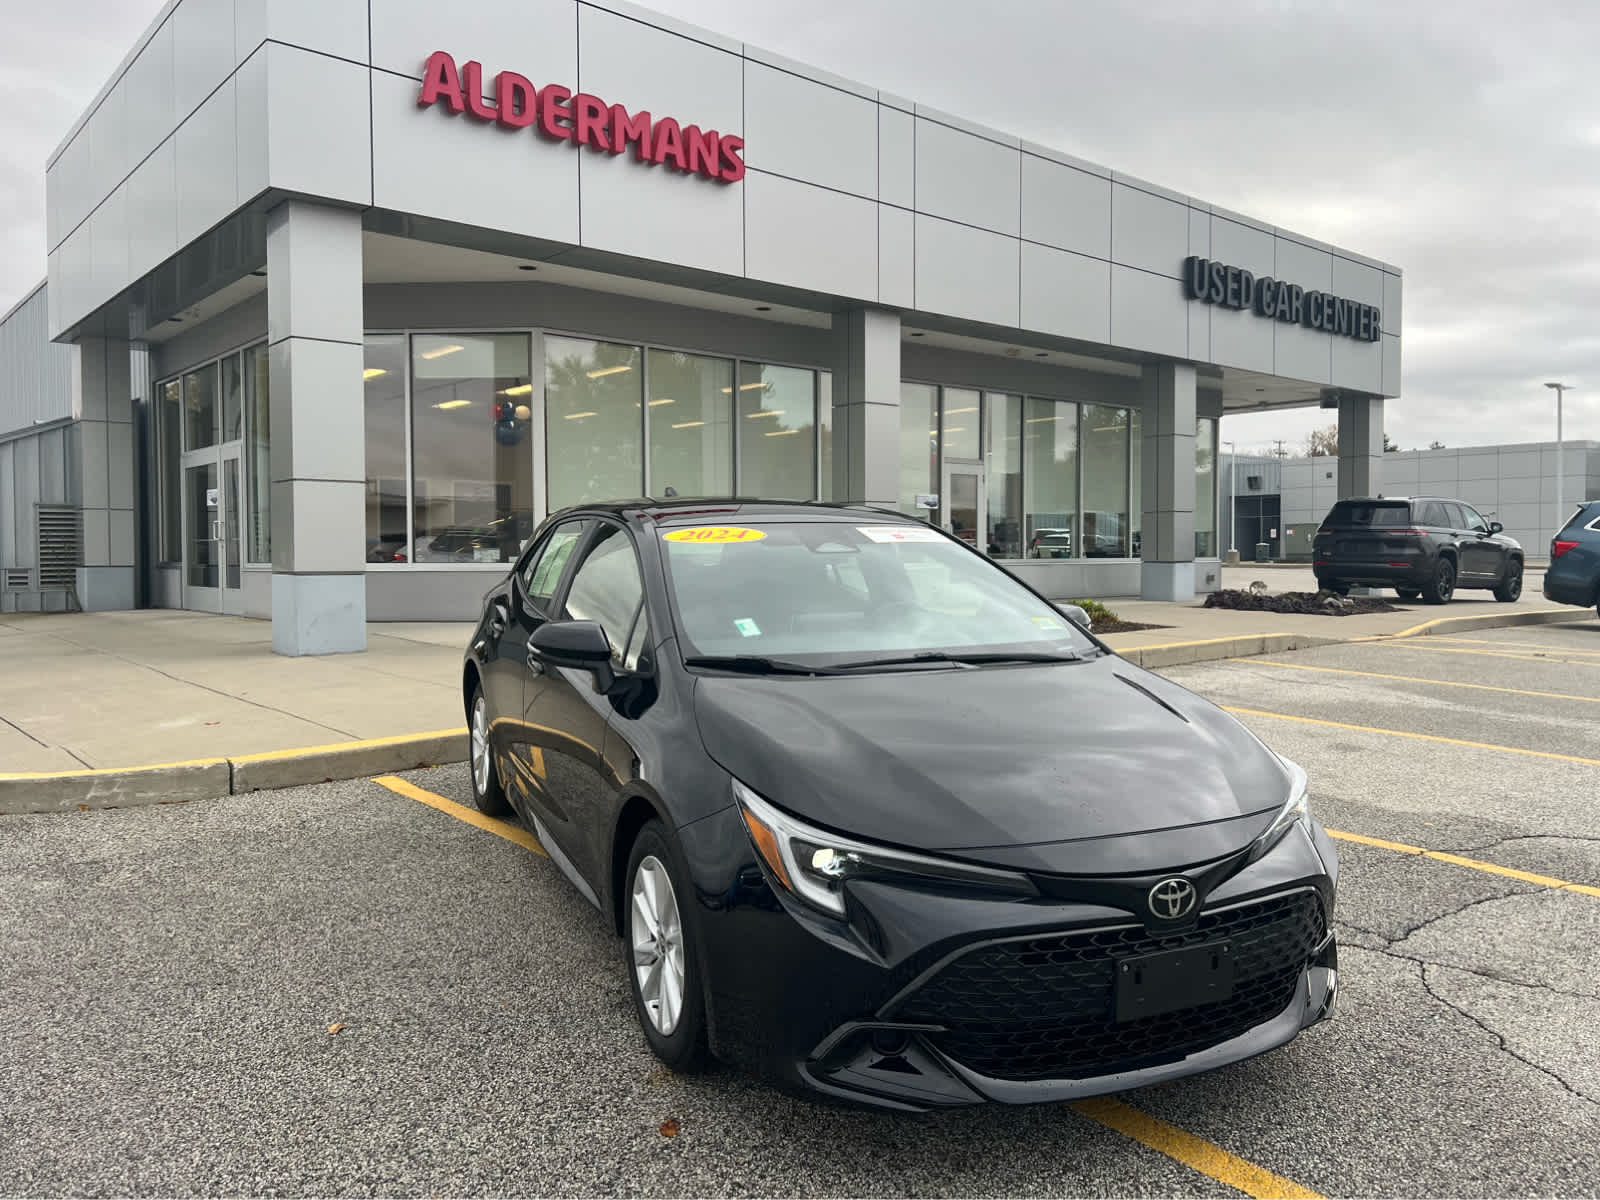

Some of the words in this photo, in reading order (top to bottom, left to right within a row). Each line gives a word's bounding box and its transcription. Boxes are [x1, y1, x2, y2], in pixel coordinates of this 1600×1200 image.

[417, 51, 746, 183] ALDERMANS
[1185, 255, 1255, 310] USED
[1256, 276, 1304, 323] CAR
[1305, 290, 1381, 342] CENTER
[679, 530, 749, 541] 2024
